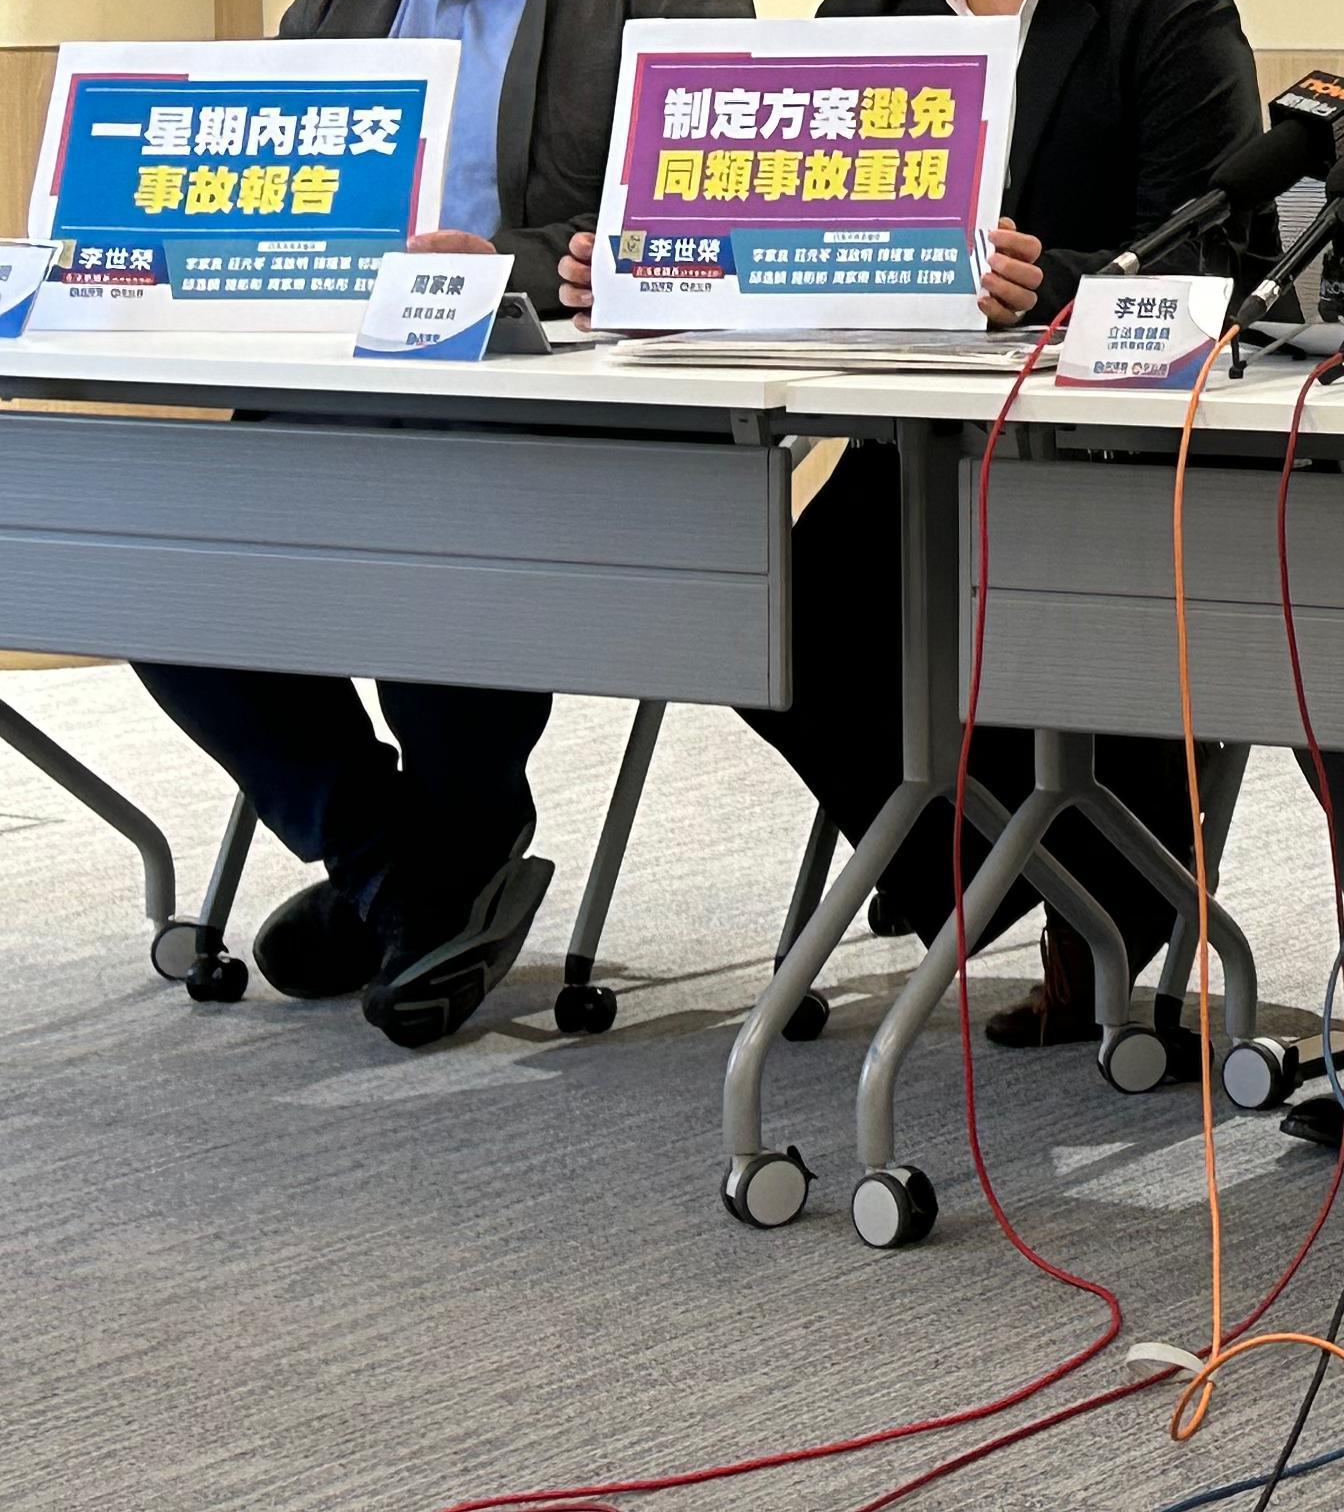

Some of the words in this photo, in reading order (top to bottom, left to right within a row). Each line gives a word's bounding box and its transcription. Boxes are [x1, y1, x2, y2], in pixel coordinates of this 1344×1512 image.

[91, 105, 402, 156] 一星期內提交
[662, 86, 956, 141] 制定方案避免
[133, 165, 340, 216] 事故報告
[653, 148, 950, 202] 同類事故重現
